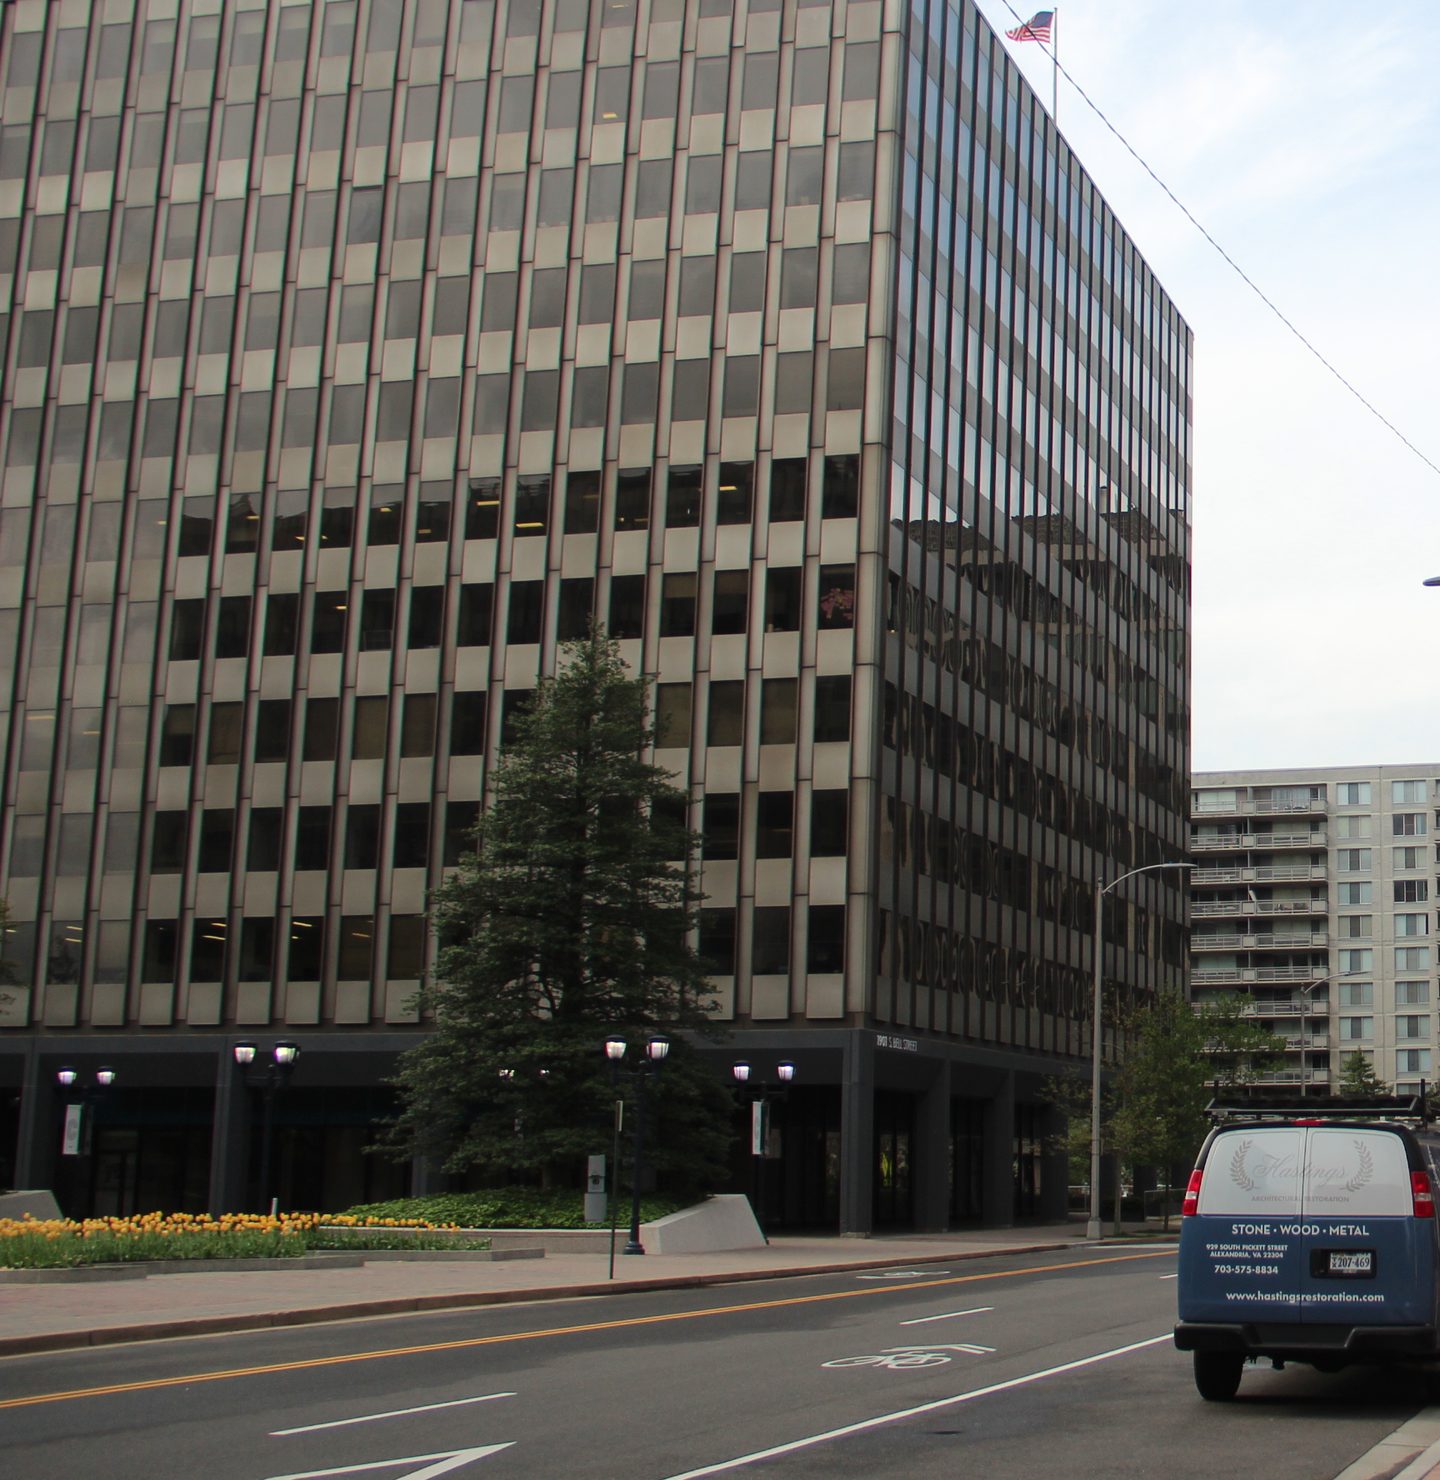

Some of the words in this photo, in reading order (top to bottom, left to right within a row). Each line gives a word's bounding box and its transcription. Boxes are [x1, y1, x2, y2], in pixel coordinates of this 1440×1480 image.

[1253, 1153, 1346, 1188] Hastings
[1231, 1224, 1271, 1235] STONE
[1279, 1224, 1320, 1236] WOOD
[1329, 1225, 1370, 1236] METAL
[1214, 1265, 1279, 1274] 703-575-8834
[1226, 1290, 1385, 1304] www.hastingsrestoration.com
